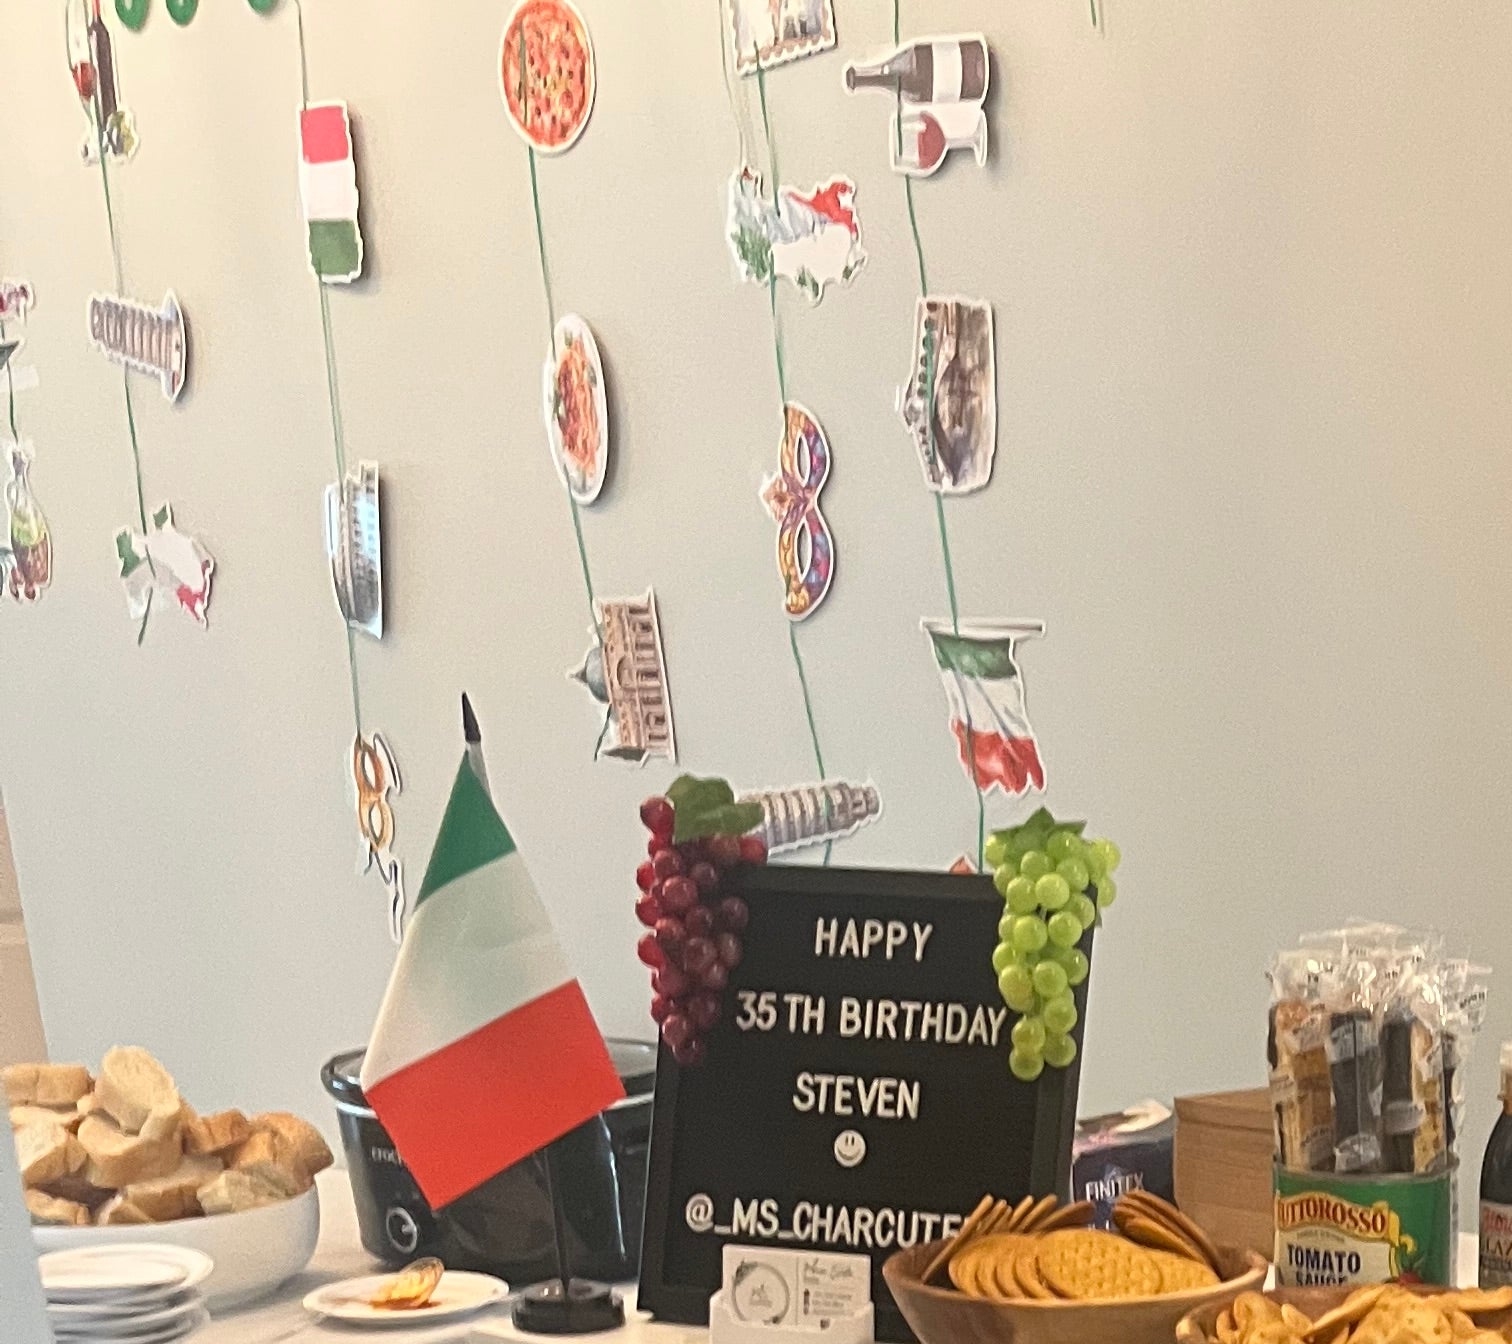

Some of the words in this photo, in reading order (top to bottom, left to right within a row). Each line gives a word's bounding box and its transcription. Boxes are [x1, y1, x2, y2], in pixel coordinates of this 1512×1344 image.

[814, 916, 934, 963] HAPPY
[735, 990, 826, 1036] 35TH
[839, 996, 1007, 1047] BIRTHDAY
[792, 1071, 921, 1121] STEVEN
[685, 1193, 972, 1249] @_MS_CHARCUTE
[1279, 1196, 1387, 1234] UTTOROSSO
[1287, 1243, 1362, 1274] TOMATO
